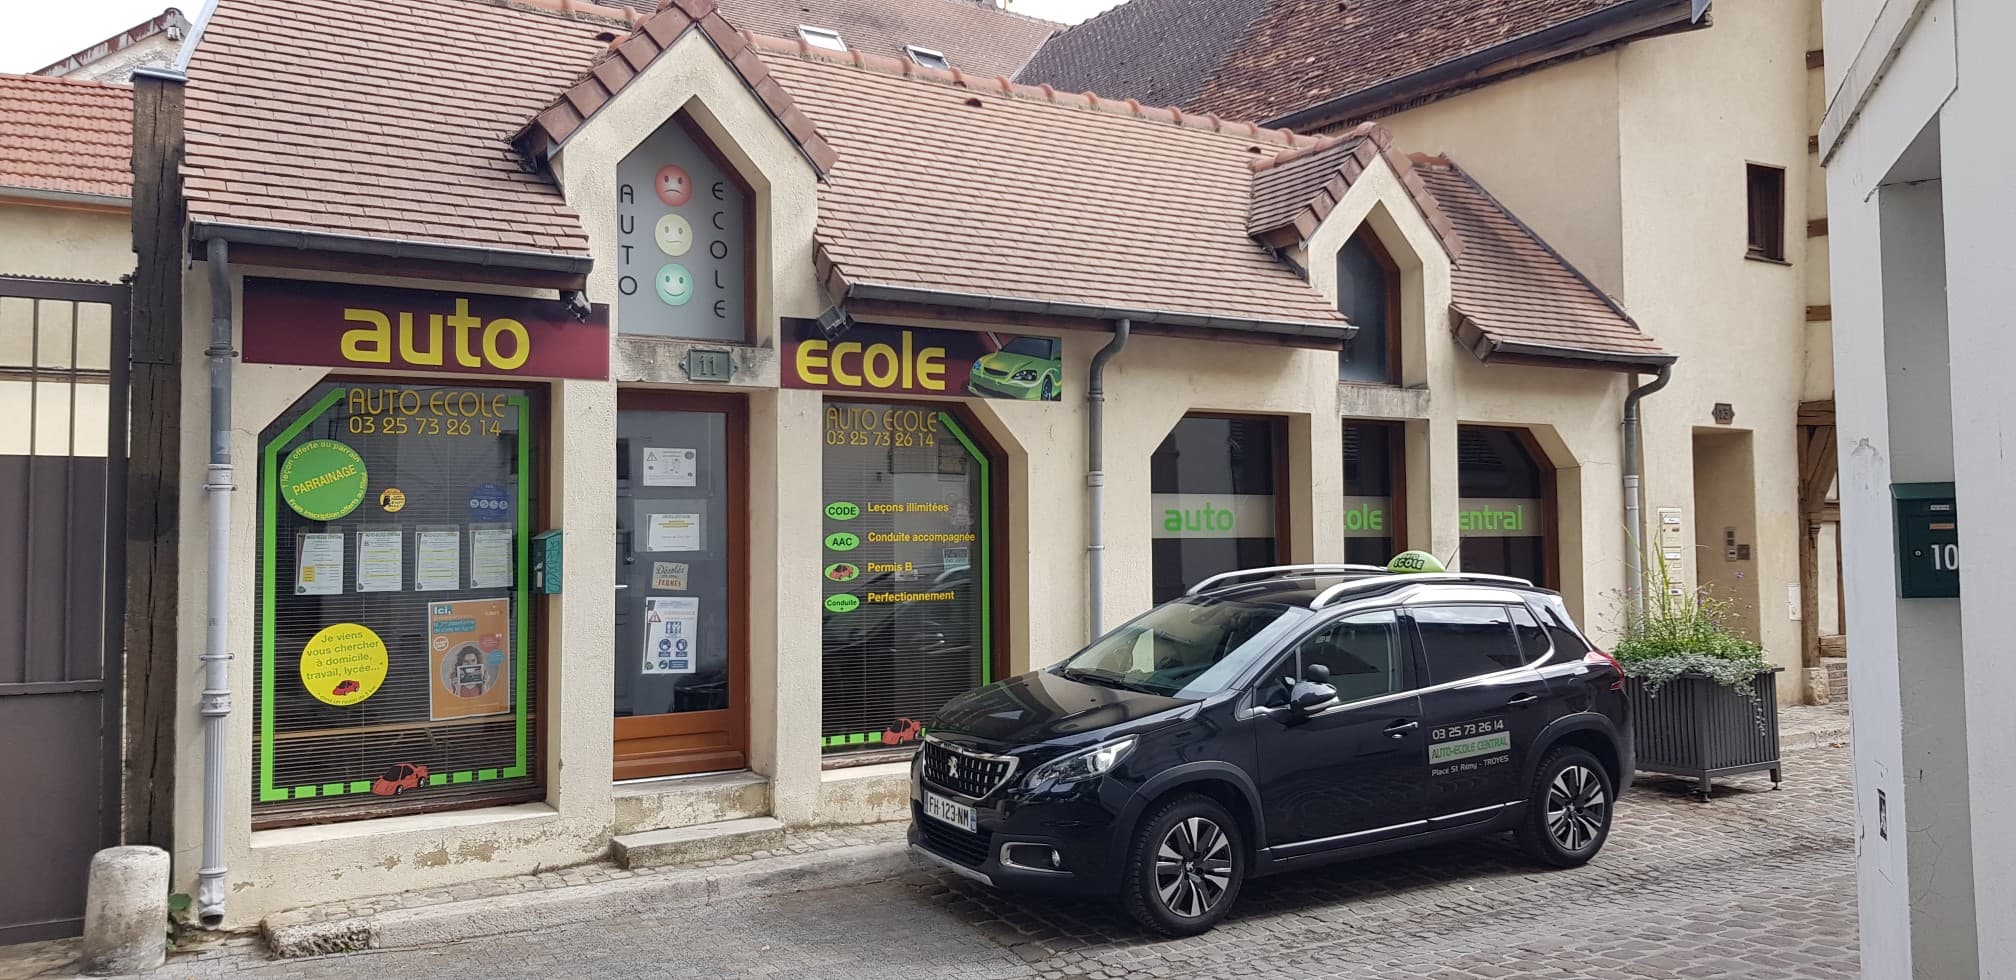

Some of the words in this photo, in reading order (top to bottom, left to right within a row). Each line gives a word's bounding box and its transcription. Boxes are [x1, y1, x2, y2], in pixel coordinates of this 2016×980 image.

[618, 184, 637, 295] AUTO
[710, 182, 728, 318] ECOLE
[341, 298, 530, 369] auto
[699, 354, 716, 376] 11
[795, 331, 946, 390] ecole
[349, 388, 421, 415] AUTO
[429, 391, 505, 418] ECOLE
[349, 416, 375, 434] 03
[382, 417, 408, 434] 25
[415, 418, 439, 435] 73
[446, 418, 471, 435] 26
[480, 419, 501, 436] 14
[826, 407, 877, 431] AUTO
[883, 410, 937, 432] ECOLE
[826, 431, 845, 445] 03
[850, 431, 868, 445] 25
[873, 432, 891, 446] 73
[895, 432, 912, 447] 26
[918, 433, 935, 447] 14
[292, 442, 319, 459] offerte
[333, 443, 360, 463] parrain
[292, 464, 358, 496] PARRAINAGE
[828, 506, 857, 516] CODE
[867, 502, 904, 514] Leçons
[906, 502, 949, 513] illimitées
[1164, 502, 1234, 531] auto
[1344, 503, 1384, 530] ole
[1459, 504, 1523, 530] entral
[832, 537, 853, 546] AAC
[867, 532, 910, 542] Conduite
[912, 532, 976, 543] accompagnée
[867, 562, 902, 572] Permis
[905, 562, 913, 571] B
[1930, 544, 1959, 570] 10
[867, 591, 955, 602] Perfectionnement
[321, 635, 334, 643] Je
[336, 631, 363, 641] viens
[306, 647, 332, 656] vous
[334, 640, 380, 653] chercher
[316, 658, 323, 667] à
[326, 653, 372, 666] domicile,
[306, 667, 342, 680] travail,
[1432, 728, 1446, 740] 03
[1448, 726, 1462, 738] 25
[1464, 724, 1476, 735] 73
[1478, 721, 1491, 732] 26
[1494, 720, 1504, 730] 14
[1431, 743, 1476, 759] AUTO-ECOLE
[1477, 738, 1508, 750] CENTRAL
[1483, 755, 1509, 766] TROYES
